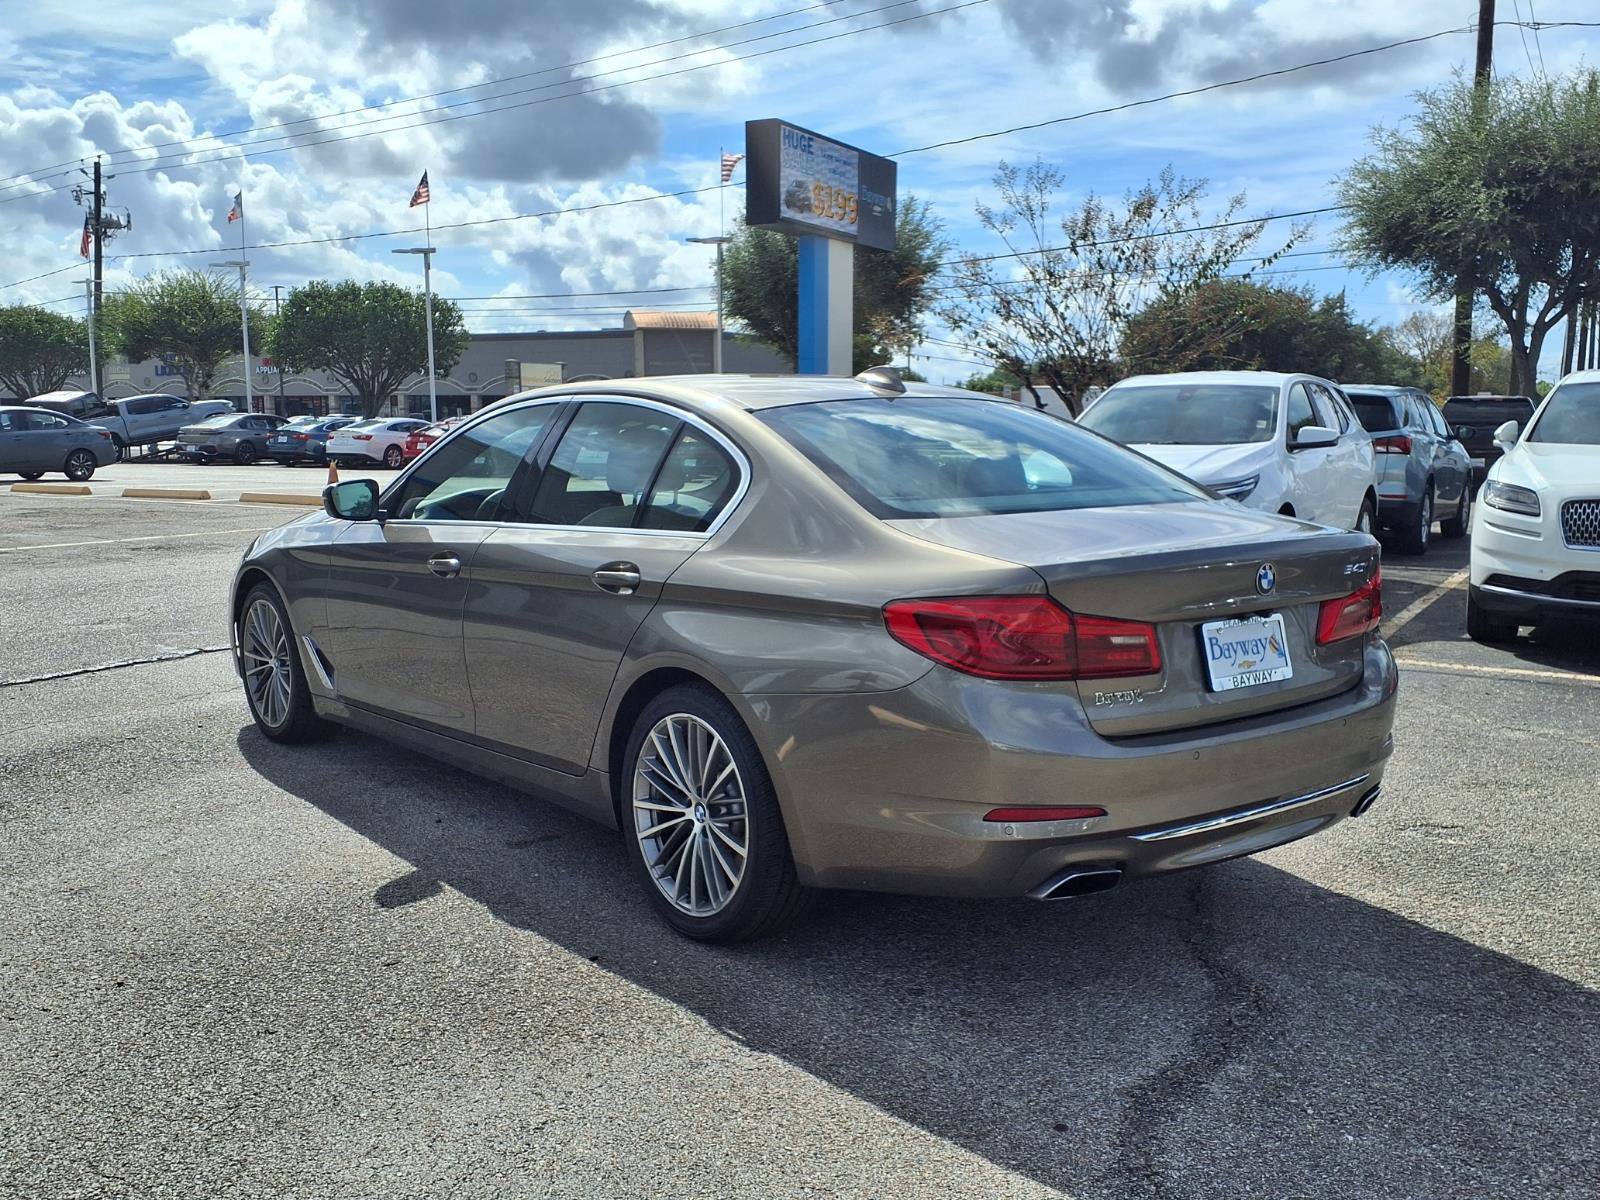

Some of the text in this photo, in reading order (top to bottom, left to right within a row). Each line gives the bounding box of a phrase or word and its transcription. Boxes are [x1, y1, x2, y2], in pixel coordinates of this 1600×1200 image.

[783, 129, 815, 155] HUGE
[811, 178, 859, 225] $199
[1208, 636, 1269, 667] Bayway
[1232, 670, 1274, 688] BAYWAY
